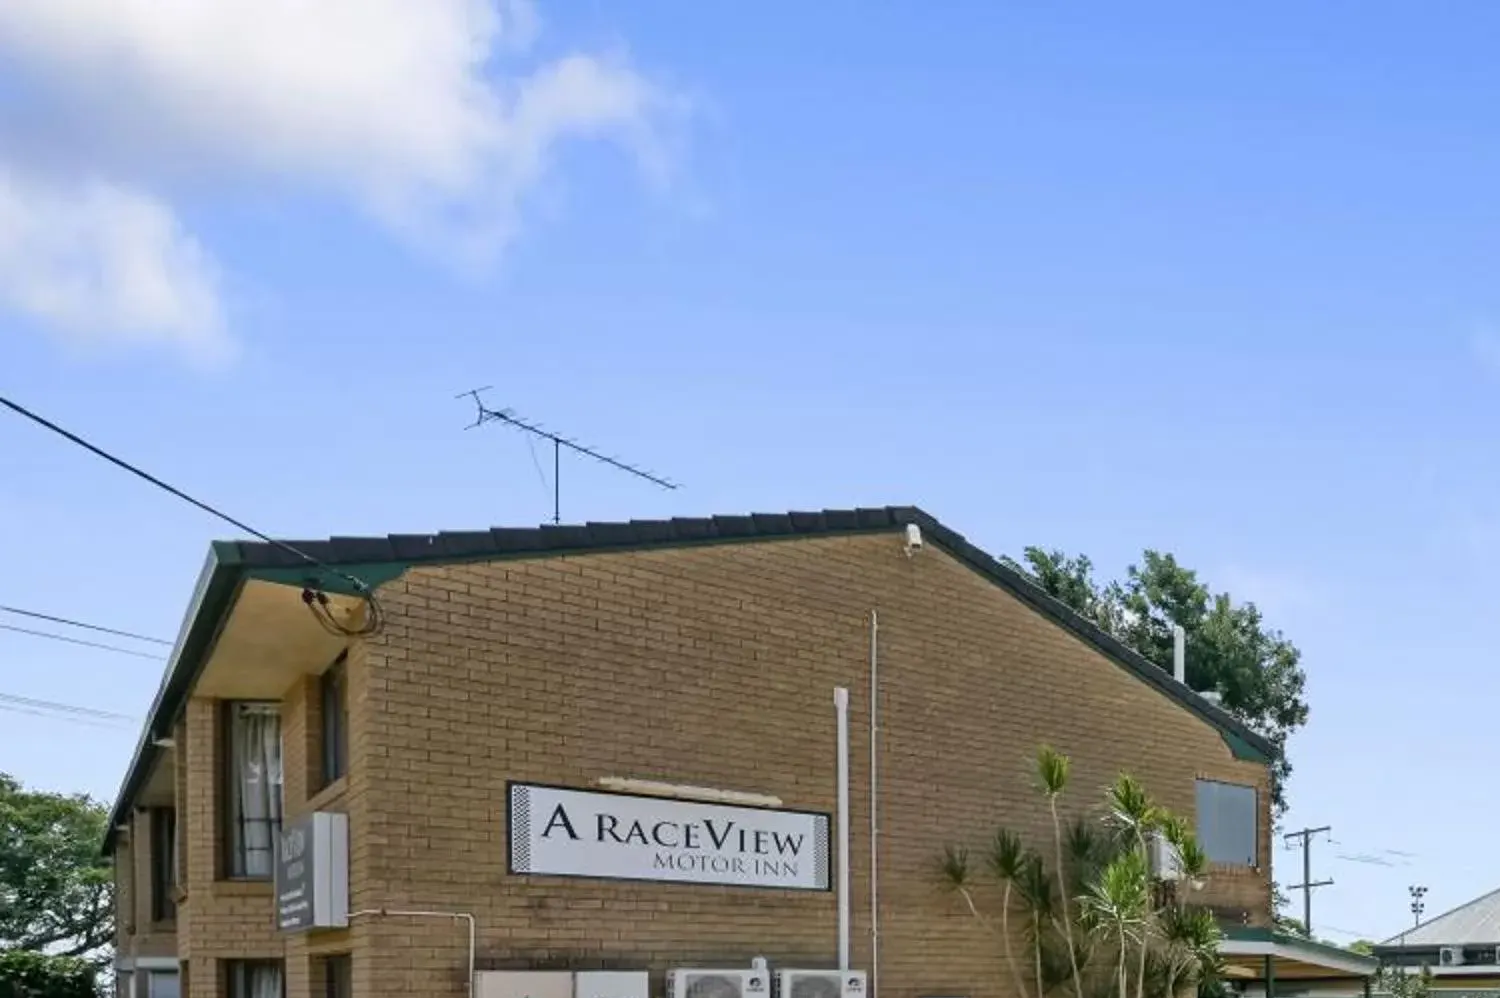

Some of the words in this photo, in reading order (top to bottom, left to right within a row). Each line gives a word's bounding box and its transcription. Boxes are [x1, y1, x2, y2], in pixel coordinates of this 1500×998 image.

[541, 803, 582, 841] A
[653, 852, 745, 874] MOTOR
[754, 858, 798, 877] INN
